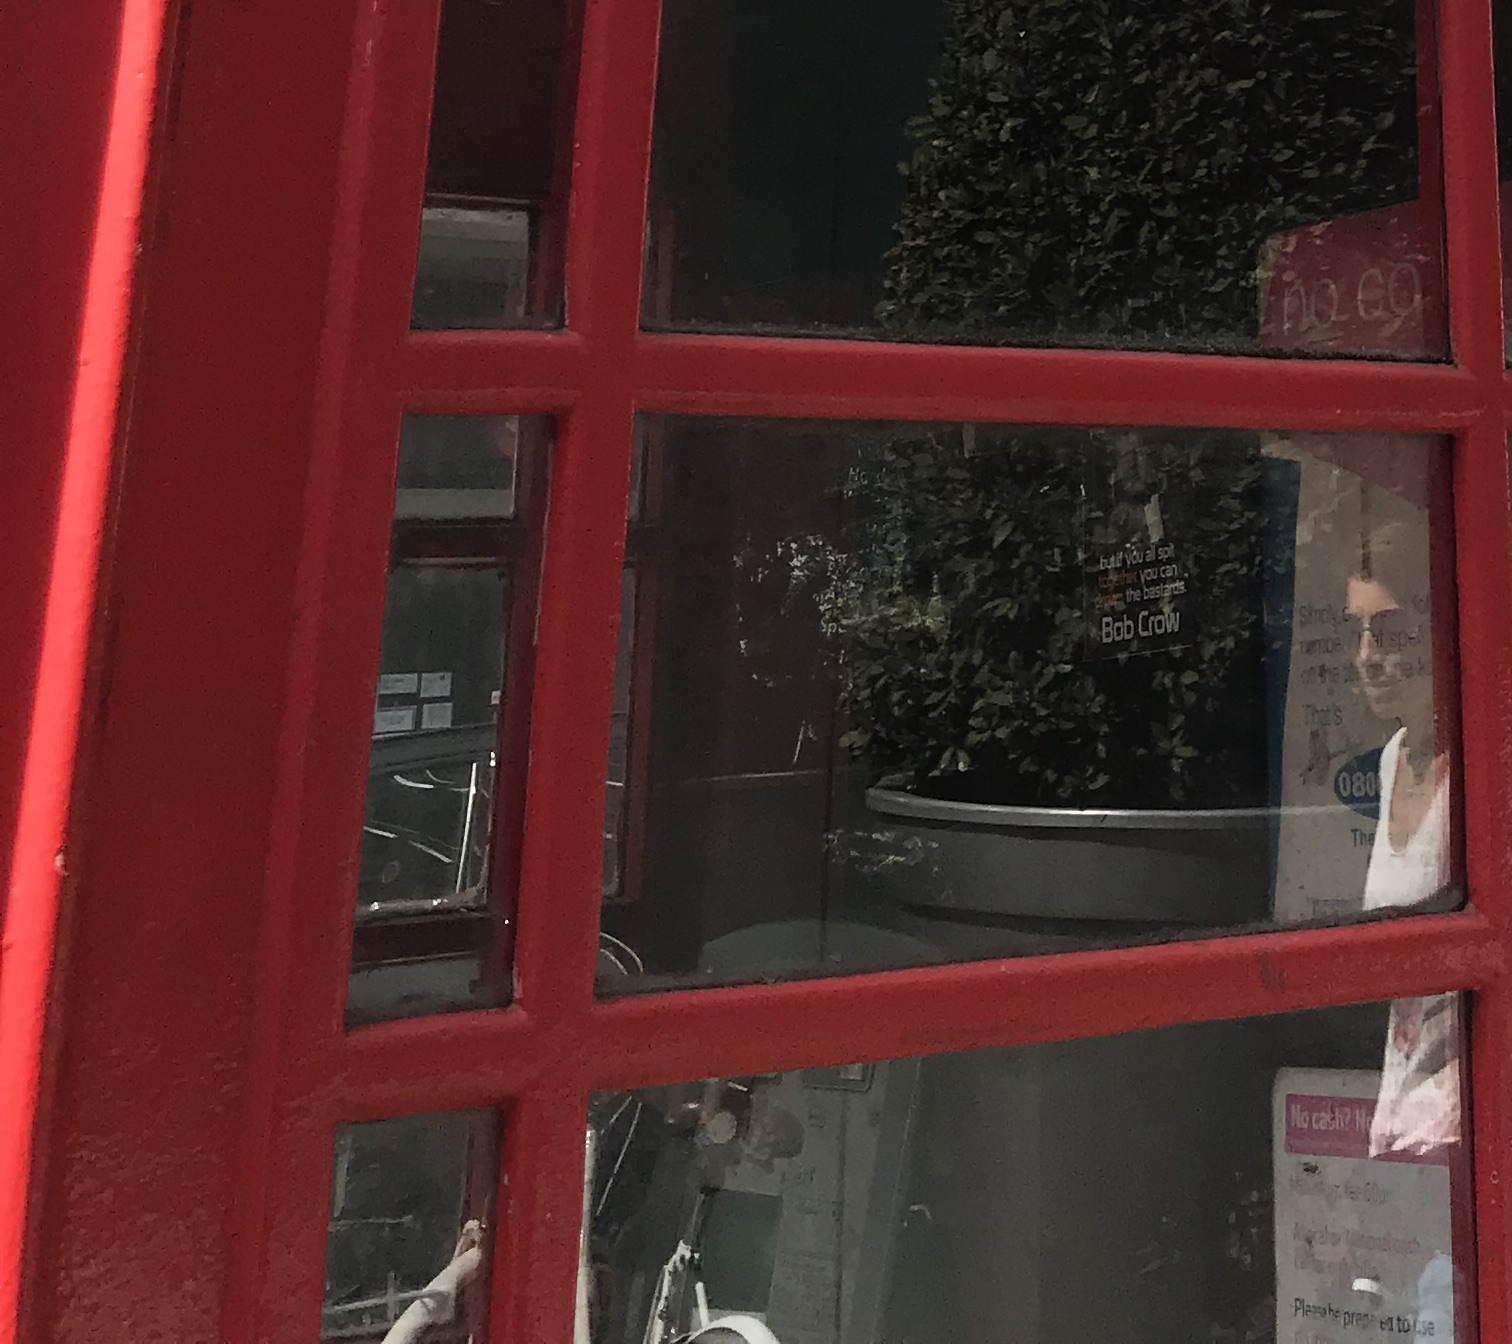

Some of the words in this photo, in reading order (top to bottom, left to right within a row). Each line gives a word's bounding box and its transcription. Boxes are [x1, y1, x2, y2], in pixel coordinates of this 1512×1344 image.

[1144, 545, 1156, 563] all
[1158, 542, 1175, 562] spit
[1139, 567, 1158, 584] you
[1160, 564, 1178, 579] can
[1126, 586, 1142, 603] the
[1102, 613, 1134, 643] Bob
[1138, 610, 1180, 638] Crow
[1338, 771, 1382, 798] 080
[1291, 1104, 1309, 1129] No
[1312, 1105, 1351, 1132] cash?
[1396, 1315, 1412, 1334] to
